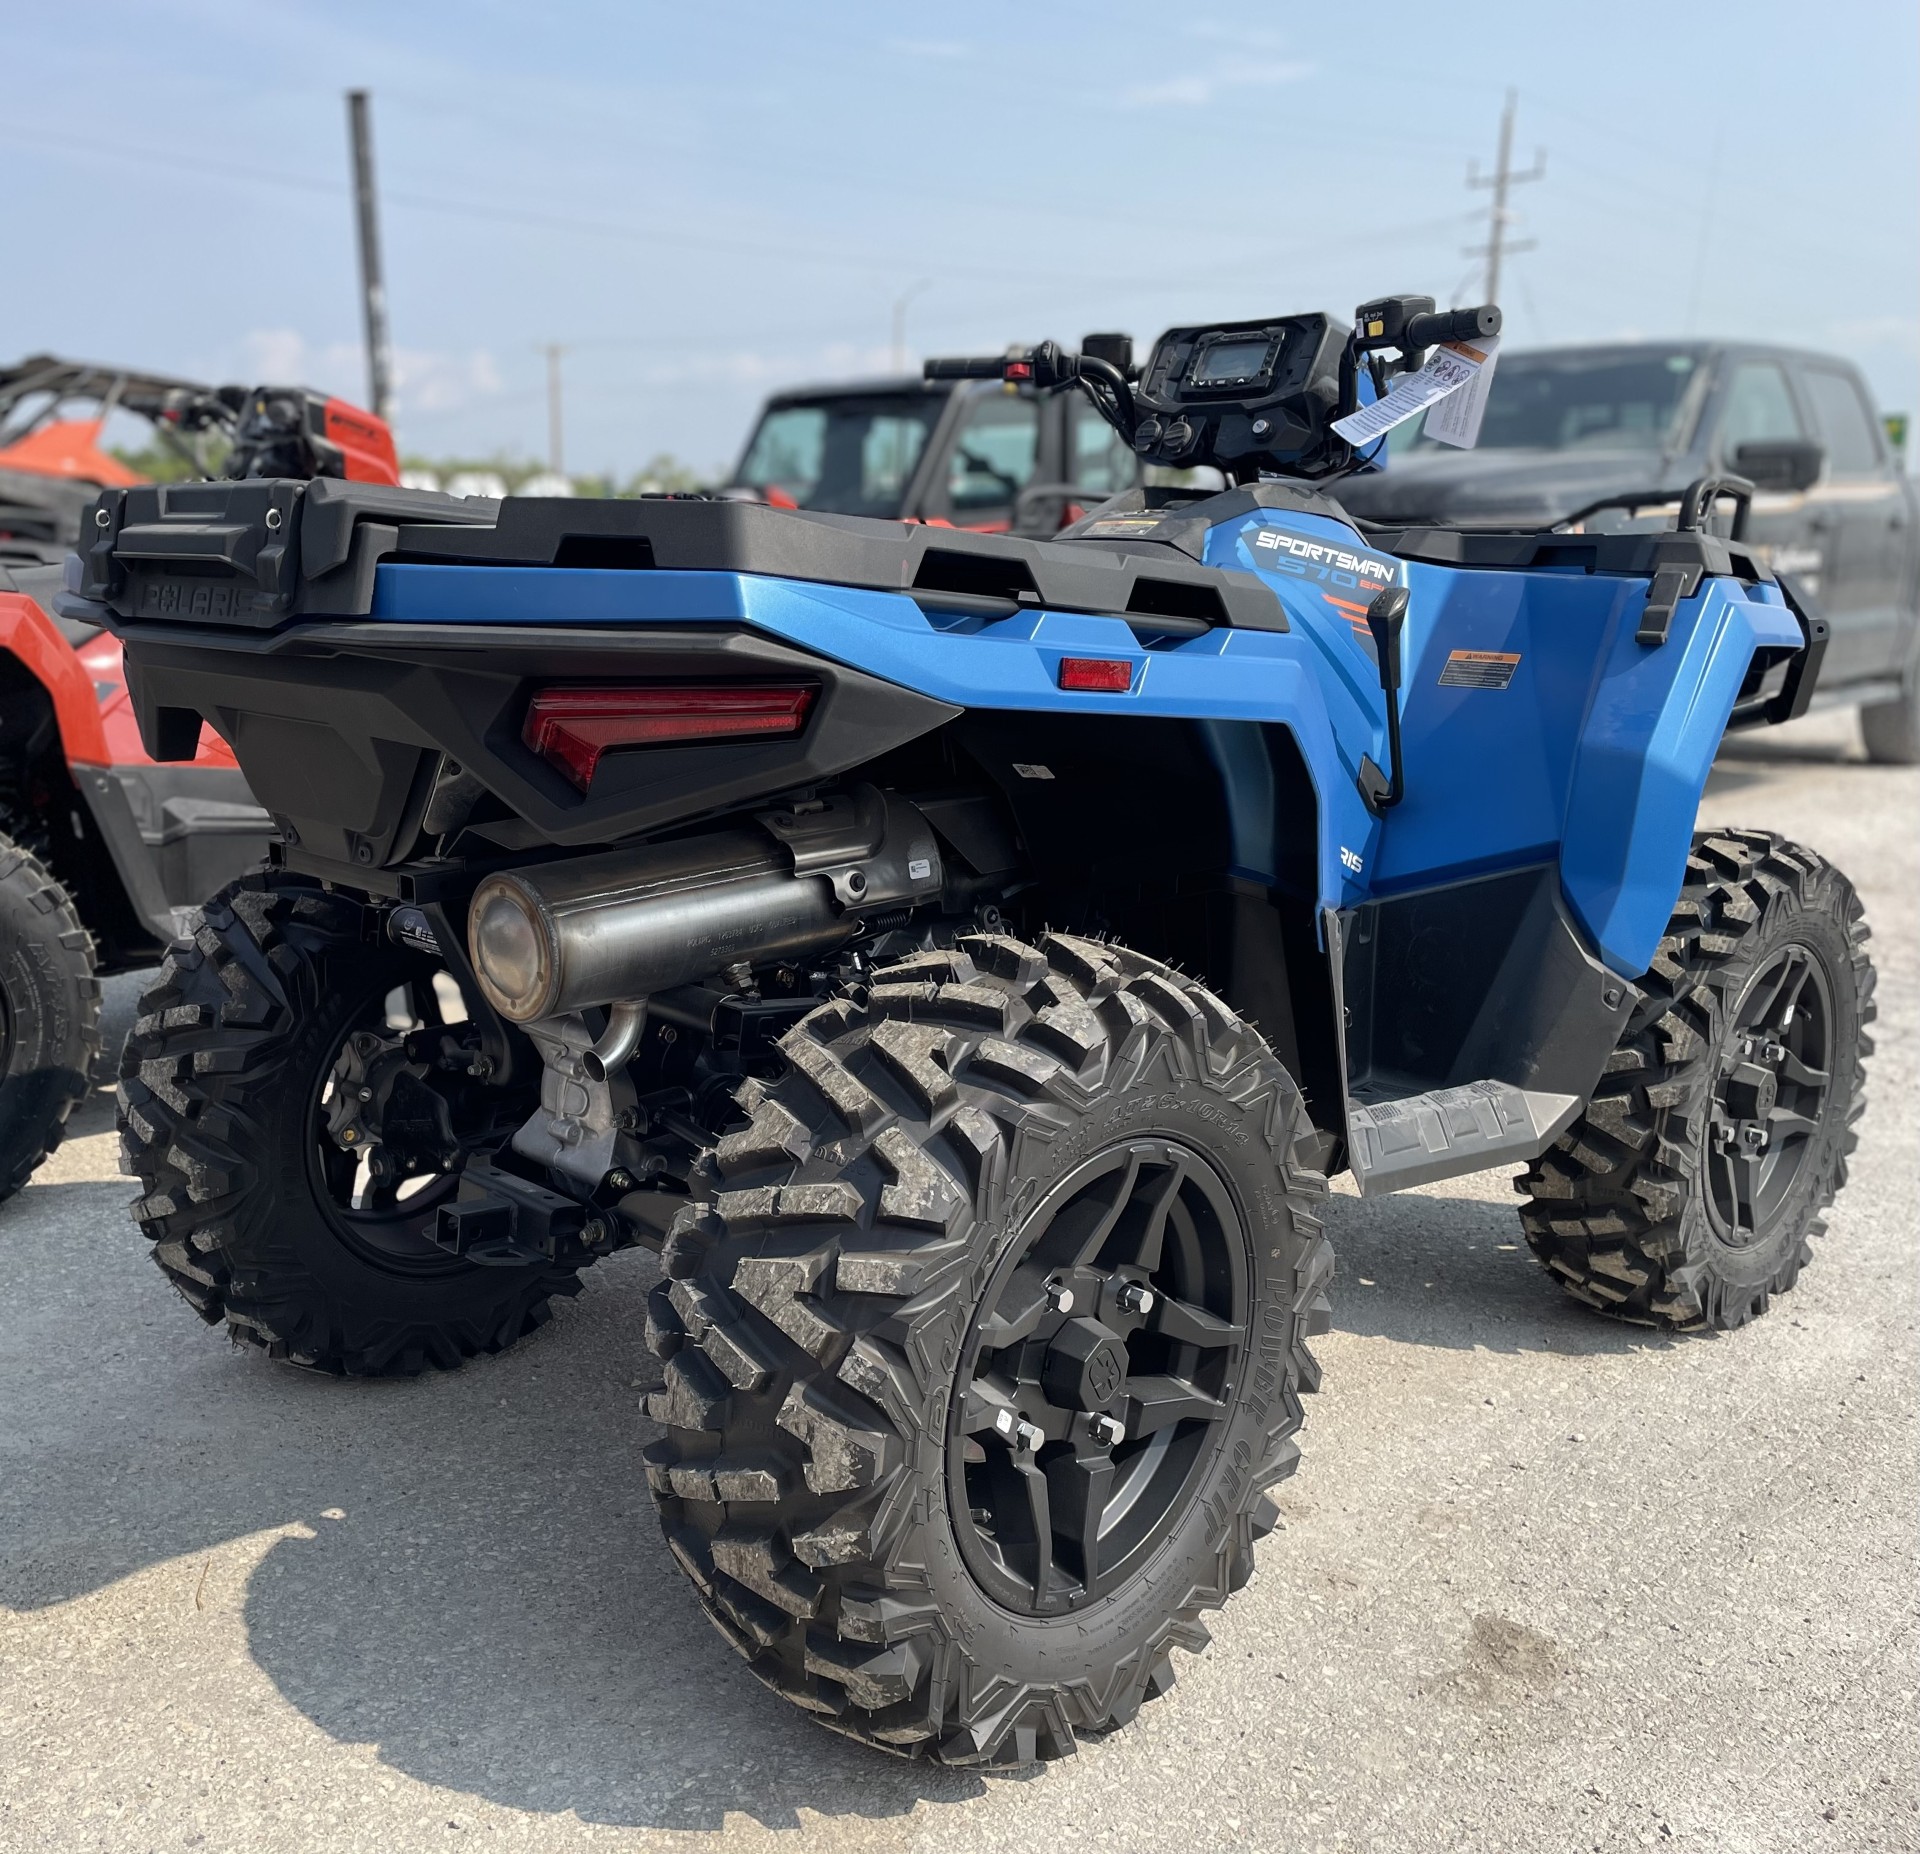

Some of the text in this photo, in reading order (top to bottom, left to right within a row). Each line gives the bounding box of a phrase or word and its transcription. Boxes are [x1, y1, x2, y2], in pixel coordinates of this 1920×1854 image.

[1256, 531, 1395, 582] SPORTSMAN
[1276, 555, 1358, 589] 570
[1472, 653, 1504, 661] WARNING
[1249, 1277, 1289, 1427] POWER
[1204, 1438, 1252, 1548] GRIP
